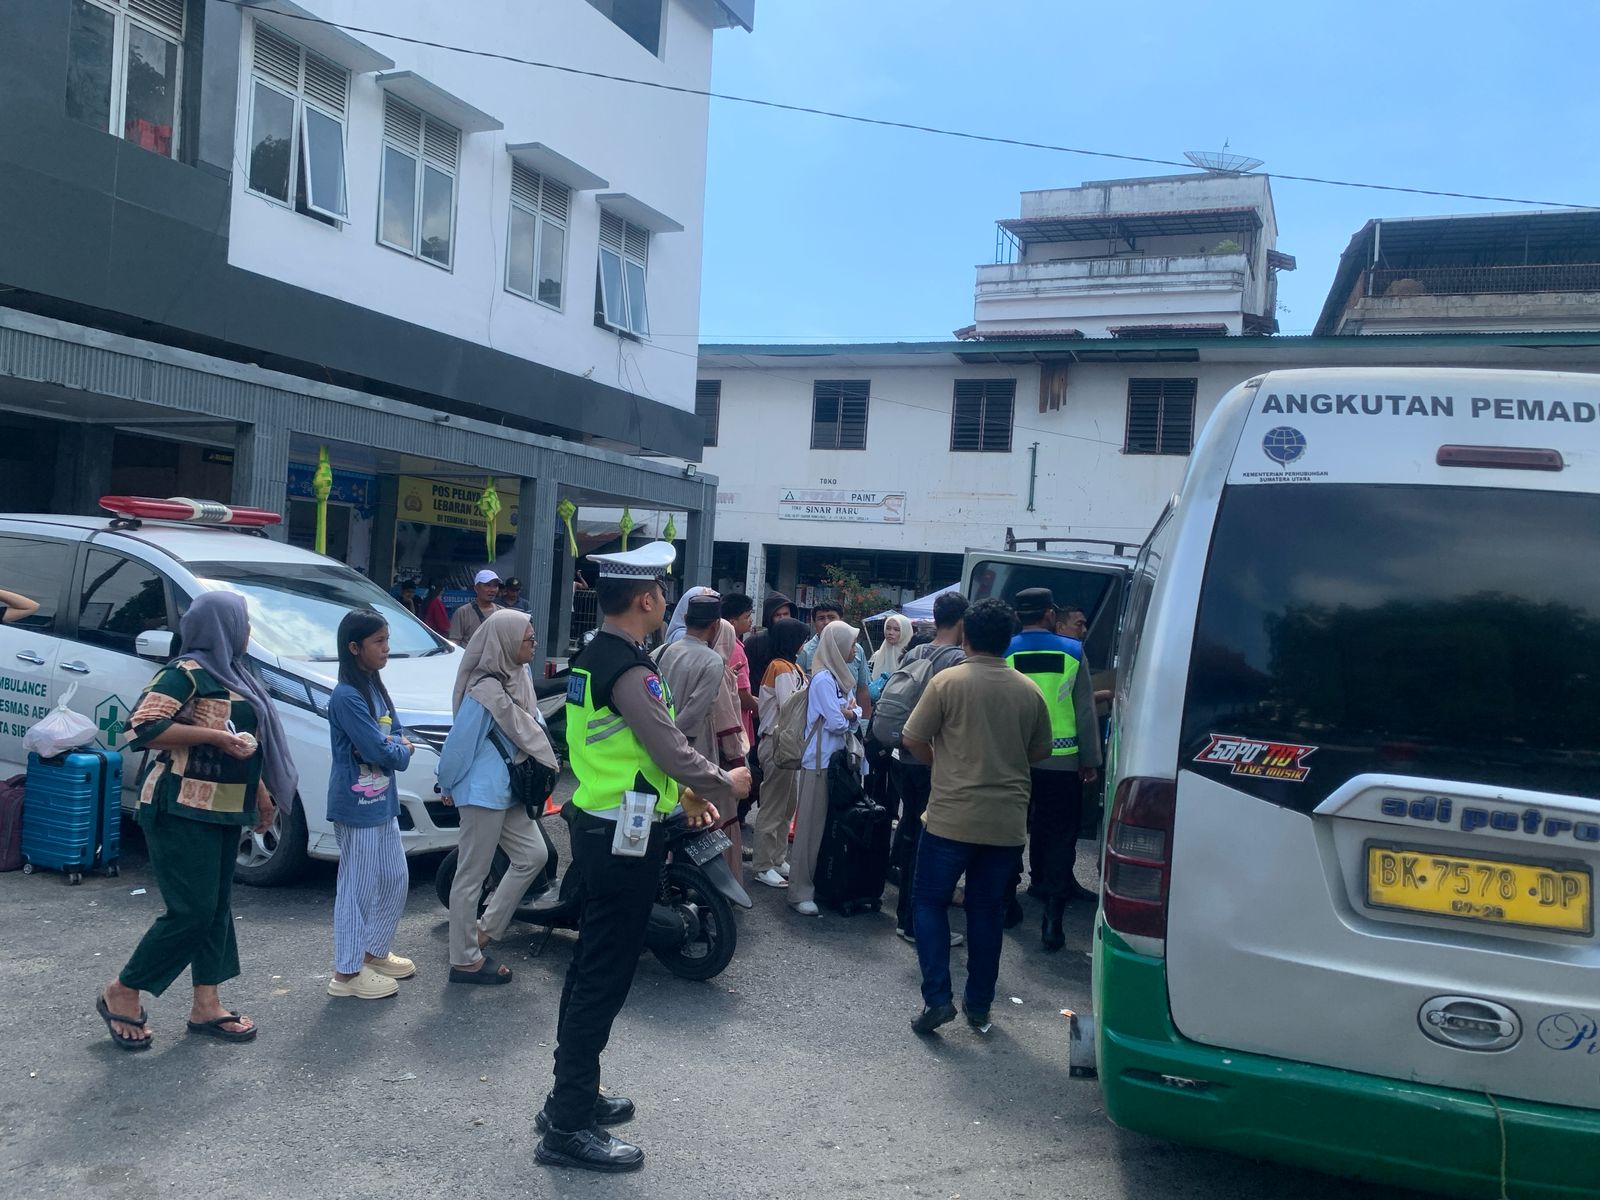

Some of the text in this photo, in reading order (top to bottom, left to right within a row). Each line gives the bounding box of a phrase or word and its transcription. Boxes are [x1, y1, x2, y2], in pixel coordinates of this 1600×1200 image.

[1261, 393, 1600, 423] ANGKUTAN PEMAD
[432, 485, 449, 497] POS
[851, 493, 876, 502] PAINT
[433, 498, 472, 516] LEBARAN
[805, 505, 831, 514] SINAR
[835, 507, 859, 516] BARU
[11, 723, 31, 738] SIB
[1236, 763, 1305, 779] LIVE MUSIK
[1381, 796, 1453, 823] adi
[1379, 853, 1582, 908] BK 7578 DP
